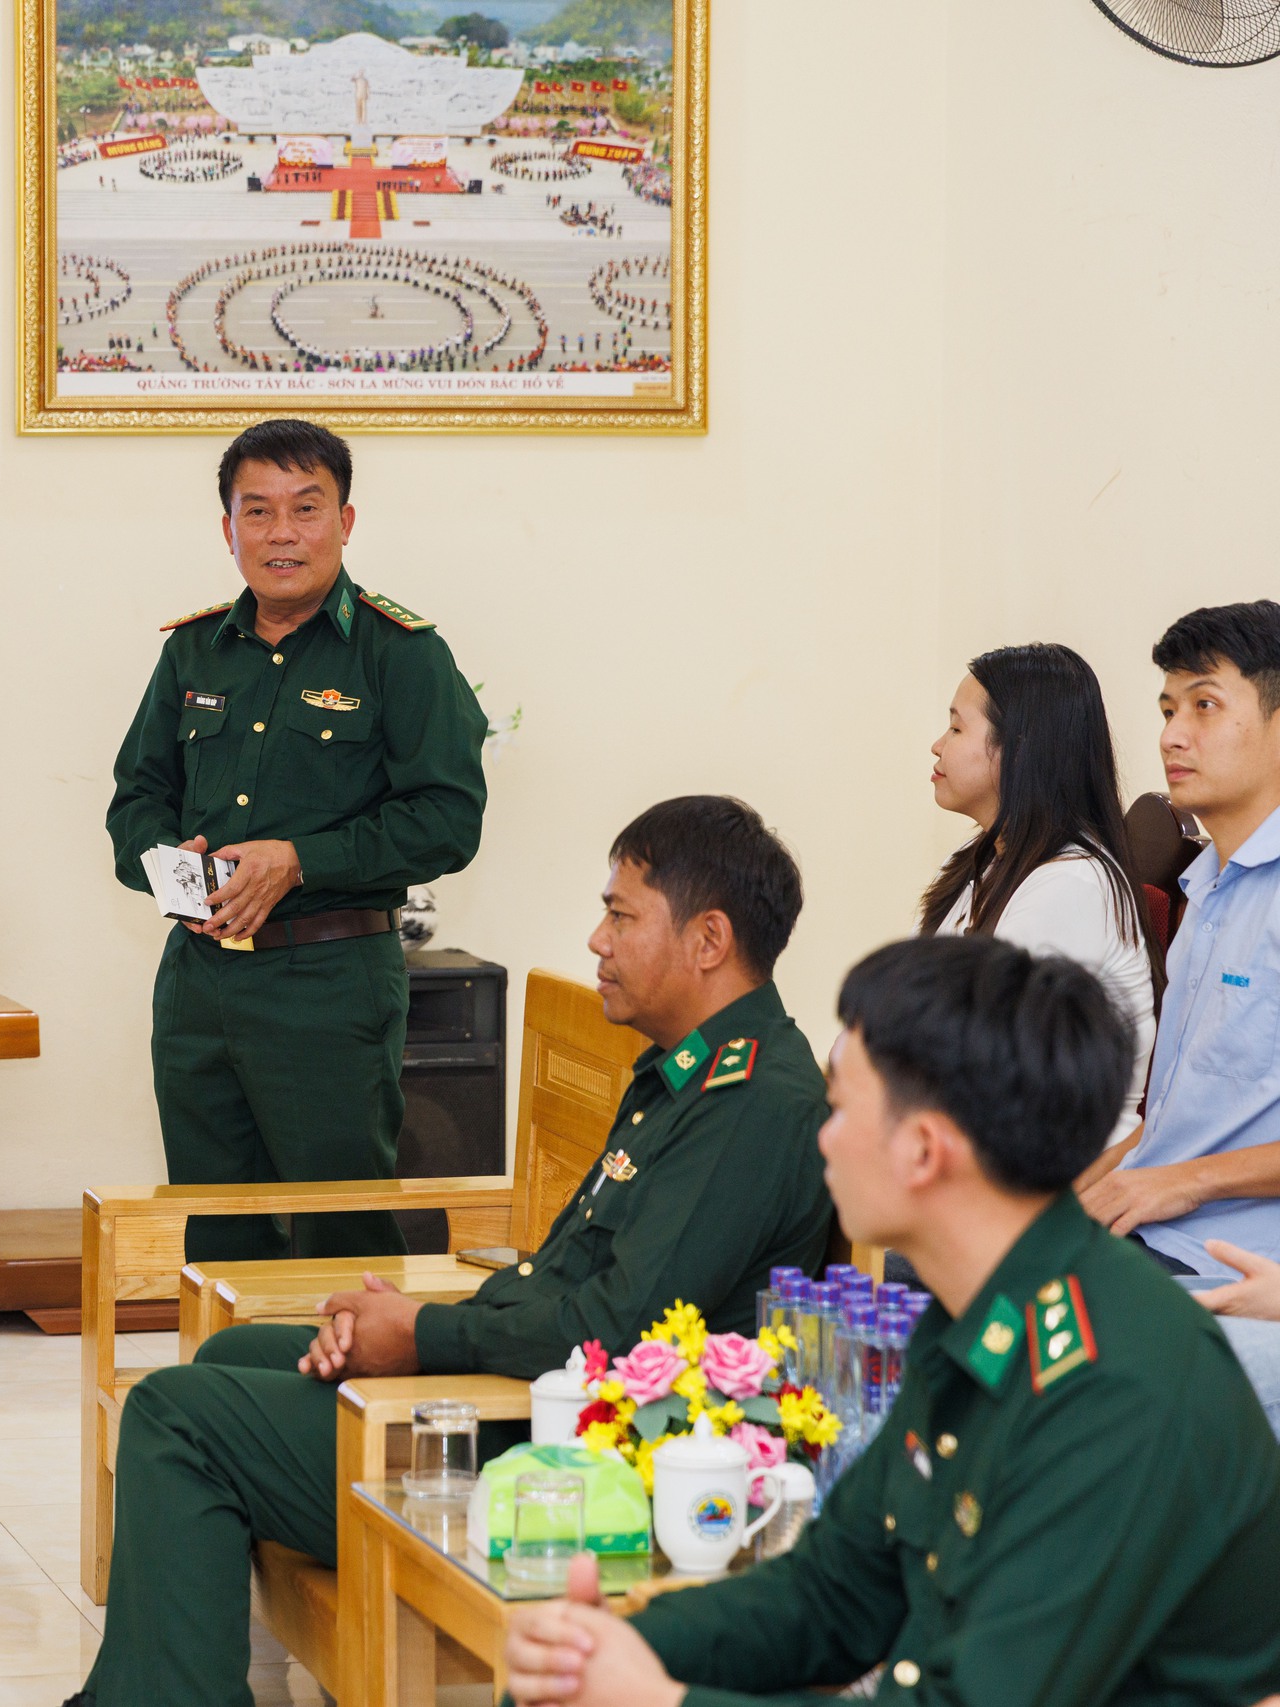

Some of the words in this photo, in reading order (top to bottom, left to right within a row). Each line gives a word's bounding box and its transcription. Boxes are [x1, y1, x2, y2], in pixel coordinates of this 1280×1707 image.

[137, 376, 187, 390] QUẢNG
[192, 376, 251, 389] TRƯỜNG
[255, 376, 282, 389] TÂY
[287, 375, 315, 389] BẮC
[328, 377, 355, 389] SƠN
[360, 379, 378, 389] LA
[382, 376, 424, 389] MỪNG
[428, 378, 453, 389] VUI
[456, 376, 486, 389] ĐÓN
[490, 376, 518, 389] BÁC
